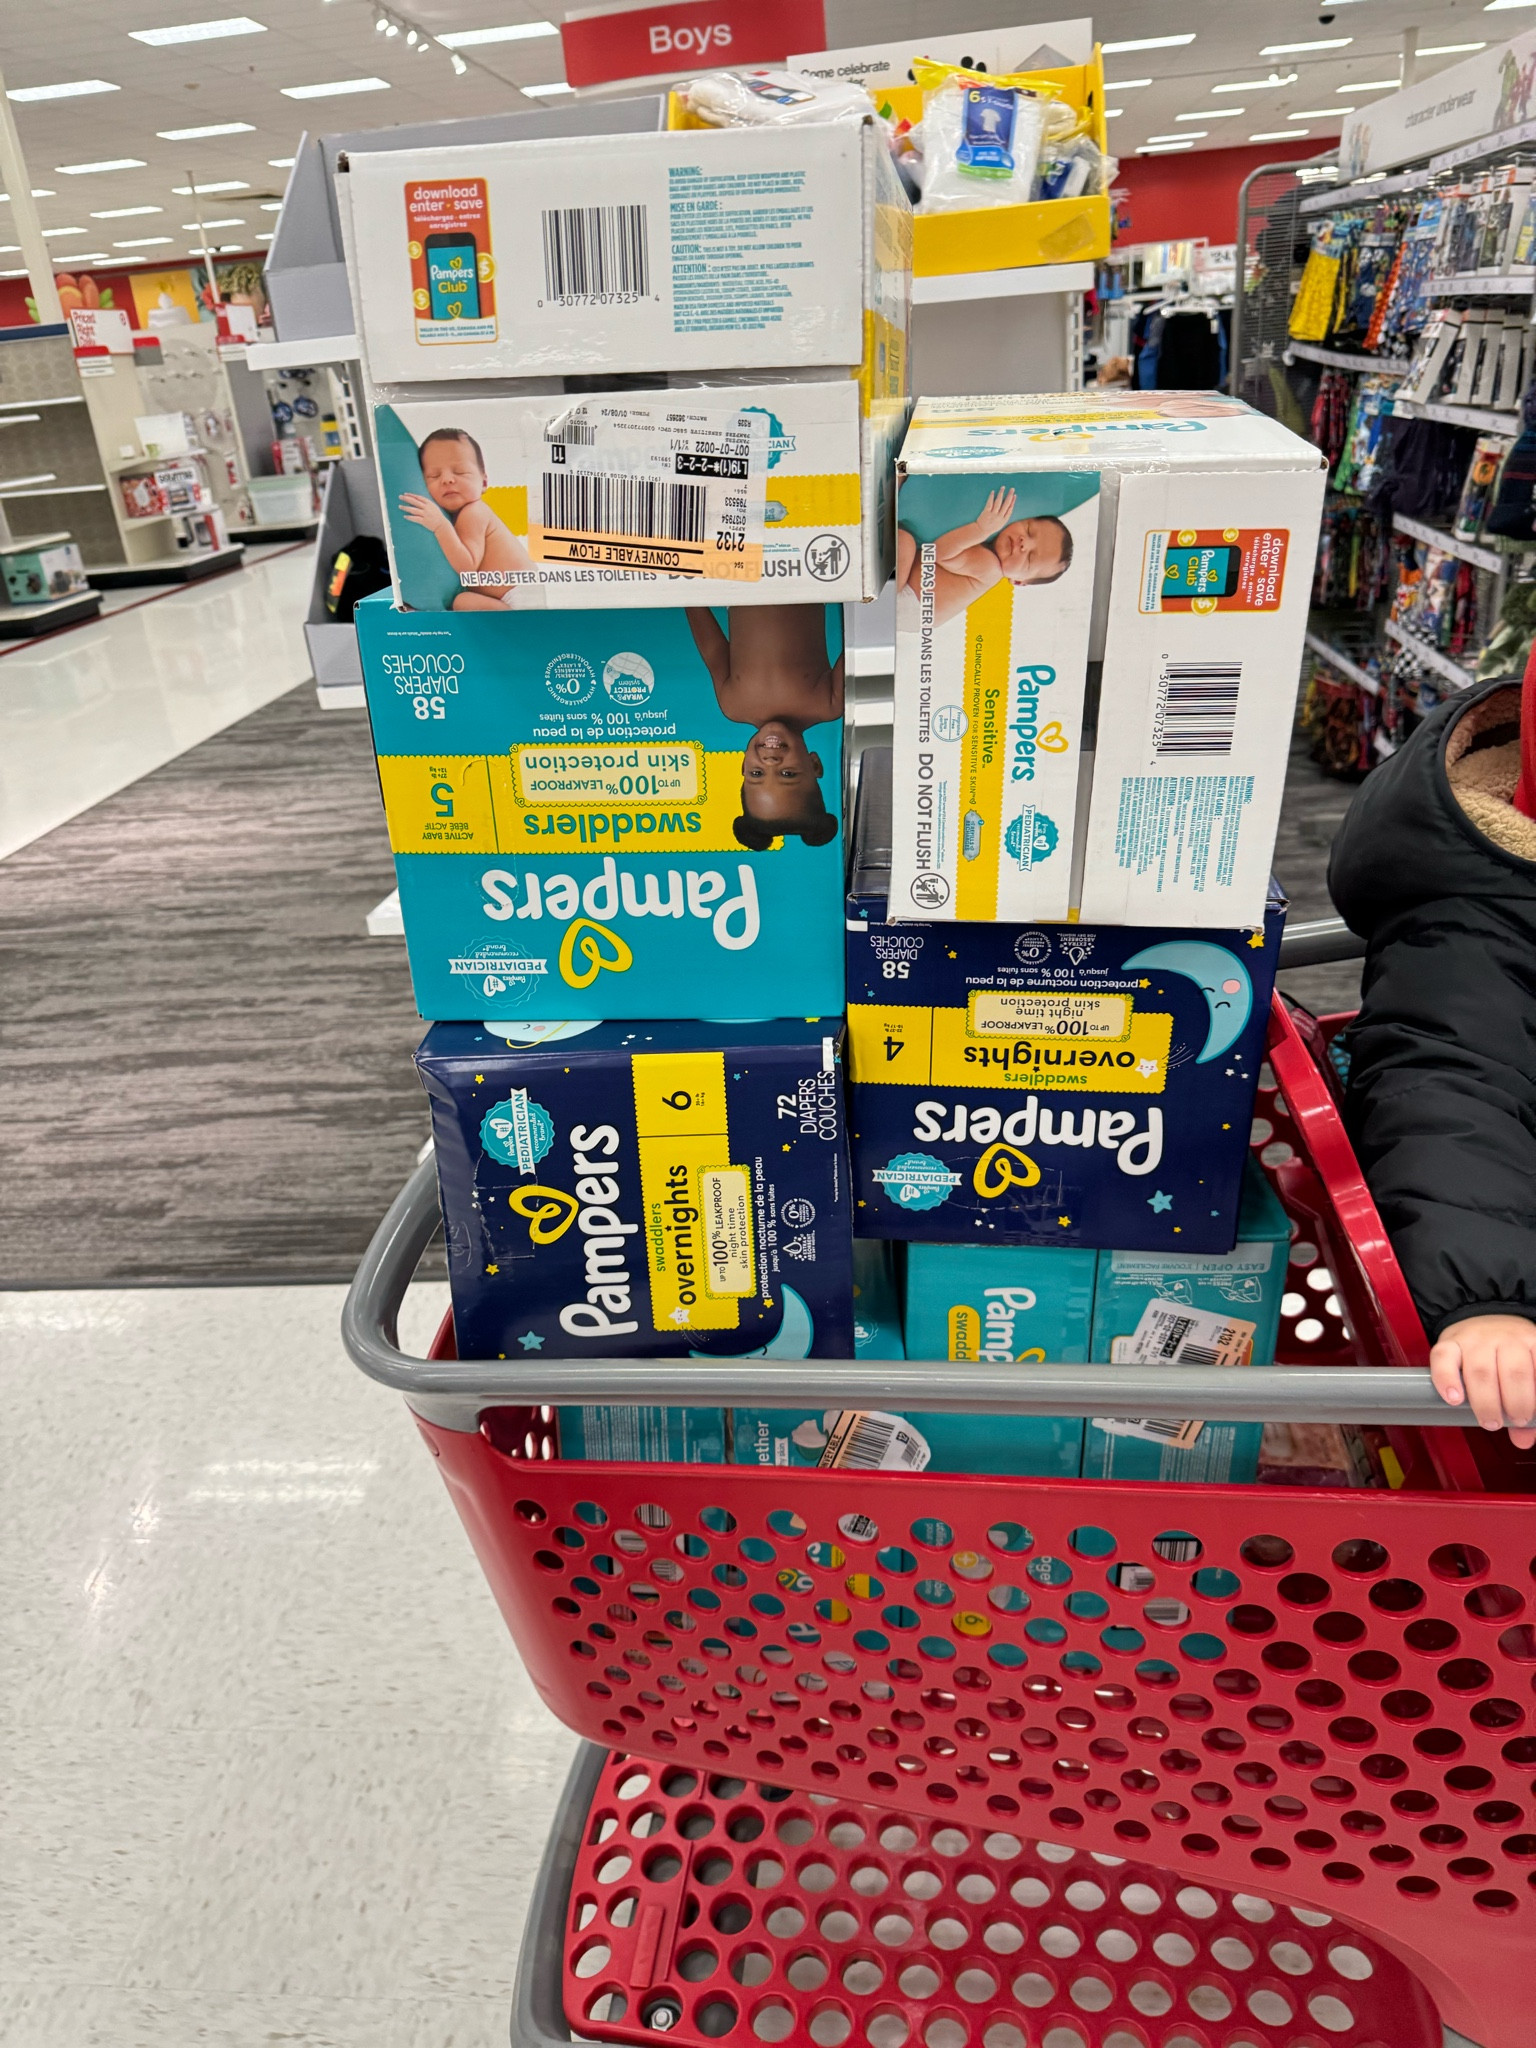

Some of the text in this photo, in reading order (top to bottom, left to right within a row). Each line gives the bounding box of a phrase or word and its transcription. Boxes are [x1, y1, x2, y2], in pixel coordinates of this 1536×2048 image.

[649, 23, 733, 55] Boys
[837, 60, 891, 77] celebrate
[413, 183, 478, 200] download
[409, 199, 483, 213] enter save
[696, 200, 719, 211] GARDE
[671, 243, 702, 254] CAUTION:
[430, 264, 474, 282] Pampers
[672, 263, 707, 274] ATTENTION
[558, 291, 639, 307] 30772 07325
[695, 441, 750, 456] 007-07-0022
[724, 497, 747, 508] 795533
[721, 514, 747, 525] 0137954
[716, 531, 745, 552] 2132
[568, 543, 680, 567] CONVEYABLE FLOW
[461, 569, 657, 586] NE PAS JETER DANS LES TOILETTES
[1197, 550, 1215, 593] Pampers
[1254, 532, 1272, 606] enter save
[1265, 538, 1284, 602] download
[919, 544, 934, 743] NE PAS JETER DANS LES TOILETTES
[382, 653, 465, 674] COUCHES
[394, 675, 459, 695] DIAPERS
[555, 678, 580, 695] 0%
[613, 686, 647, 694] PROTECT
[1156, 674, 1169, 709] 30772
[412, 696, 446, 720] 58
[539, 709, 668, 725] jusqu'à 100 % sans fuites
[969, 643, 983, 774] CLINICALLY PROVEN FOR SENSITIVE
[532, 723, 677, 739] protection de la peau
[1008, 664, 1057, 782] Pampers
[1152, 712, 1165, 747] 07325
[524, 749, 690, 773] skin protection
[530, 779, 603, 791] LEAKPROOF
[658, 779, 669, 788] TO
[669, 779, 681, 788] UP
[1167, 777, 1178, 806] ATTENTION
[1182, 776, 1194, 802] CAUTION:
[1243, 776, 1255, 804] WARNING:
[430, 782, 454, 818] 5
[1214, 776, 1228, 817] MISE EN GARDE
[916, 753, 933, 870] DO NOT FLUSH
[422, 831, 474, 840] ACTIVE BABY
[424, 822, 469, 832] BÉBÉ ACTIF
[523, 811, 702, 843] swaddlers
[1021, 809, 1033, 868] PEDIATRICIAN
[481, 856, 761, 952] Pampers
[870, 935, 924, 948] COUCHES
[875, 948, 918, 960] DIAPERS
[454, 961, 542, 971] PEDIATRICIAN
[882, 961, 911, 979] 58
[997, 967, 1019, 975] fuites
[1041, 968, 1051, 977] %
[1054, 968, 1075, 978] 100
[965, 975, 1139, 990] protection nocturne de la peau
[1000, 997, 1101, 1010] skin protection
[1015, 1007, 1084, 1019] night time
[980, 1020, 1043, 1030] LEAKPROOF
[883, 1035, 905, 1062] 4
[963, 1041, 1136, 1073] overnights
[1003, 1072, 1088, 1086] swaddlers
[662, 1090, 692, 1111] 6
[776, 1094, 797, 1120] 72
[797, 1078, 818, 1133] DIAPERS
[816, 1071, 838, 1141] COUCHES
[514, 1093, 532, 1170] PEDIATRICIAN
[529, 1112, 539, 1152] recommended
[913, 1095, 1164, 1176] Pampers
[876, 1172, 957, 1183] PEDIATRICIAN
[712, 1177, 724, 1229] LEAKPROOF
[559, 1124, 639, 1337] Pampers
[727, 1207, 740, 1258] night time
[737, 1195, 749, 1269] skin protection
[754, 1156, 772, 1298] protection nocturne de la peau
[767, 1219, 777, 1228] %
[649, 1203, 667, 1273] swaddlers
[664, 1164, 698, 1306] overnights
[768, 1230, 777, 1247] 100
[1202, 1263, 1233, 1271] OPEN
[1237, 1263, 1267, 1271] EASY
[720, 1274, 726, 1282] UP
[1217, 1327, 1236, 1347] 2132
